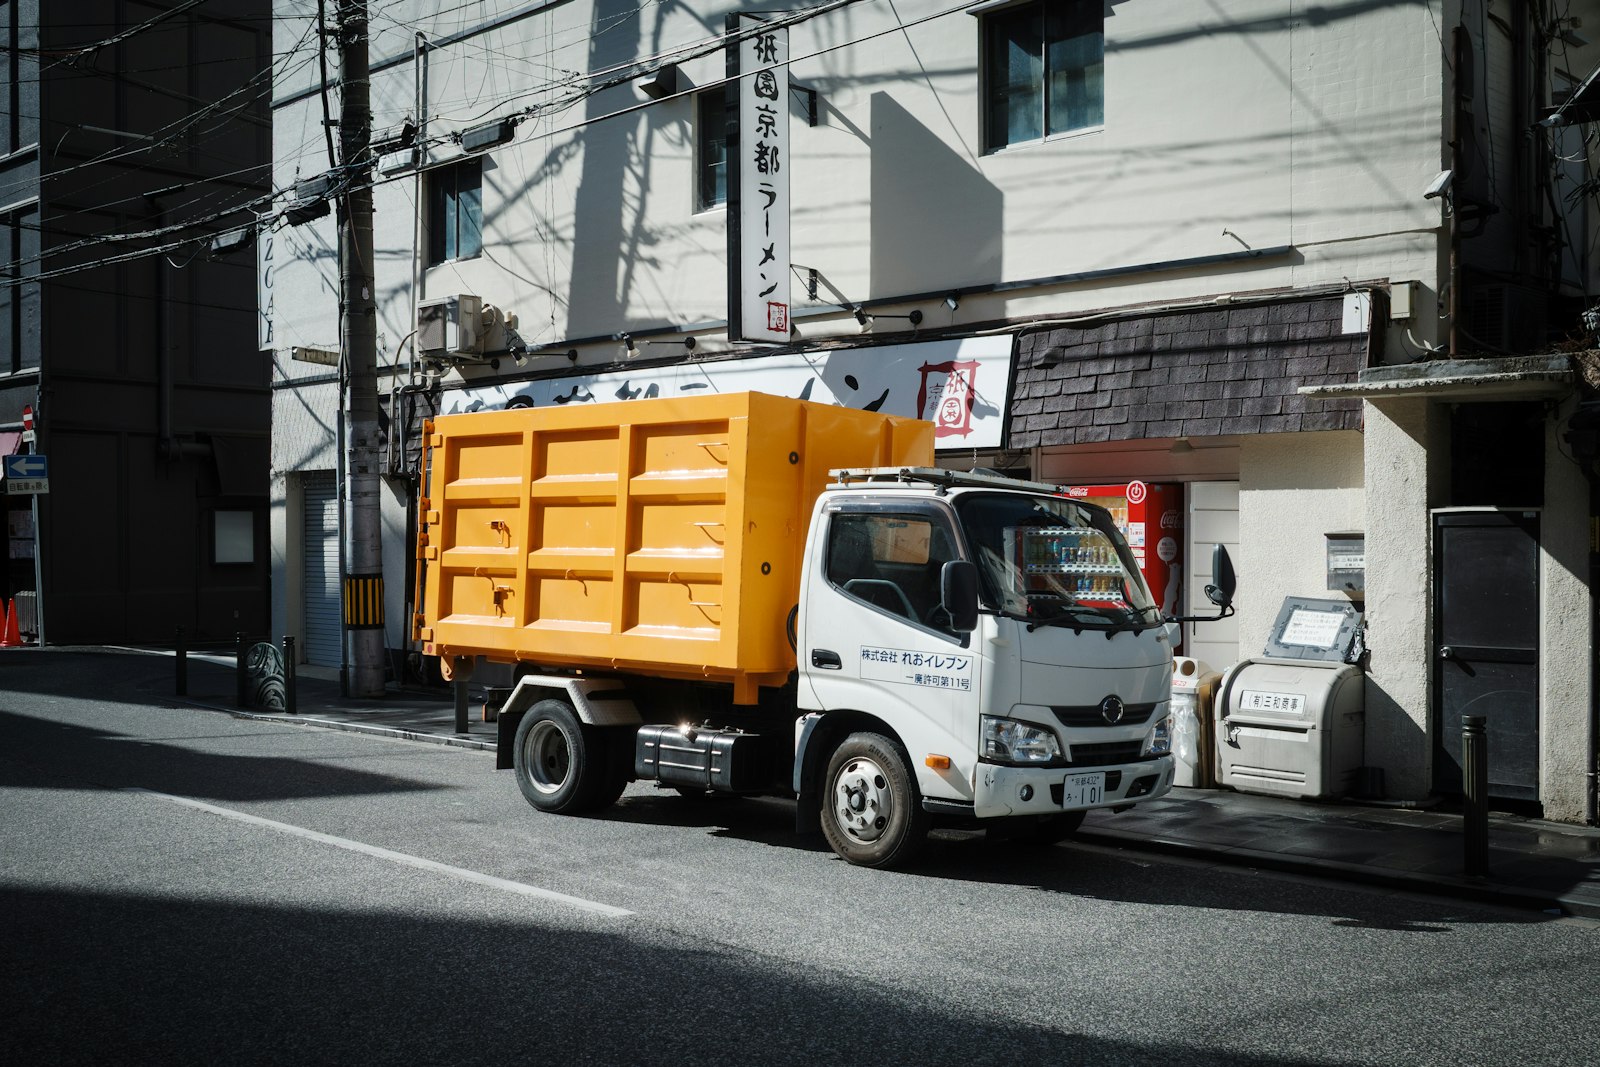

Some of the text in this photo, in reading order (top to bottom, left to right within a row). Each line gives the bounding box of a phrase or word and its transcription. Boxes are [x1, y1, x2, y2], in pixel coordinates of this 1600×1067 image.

[861, 649, 968, 670] 株式会社 れおイレブン
